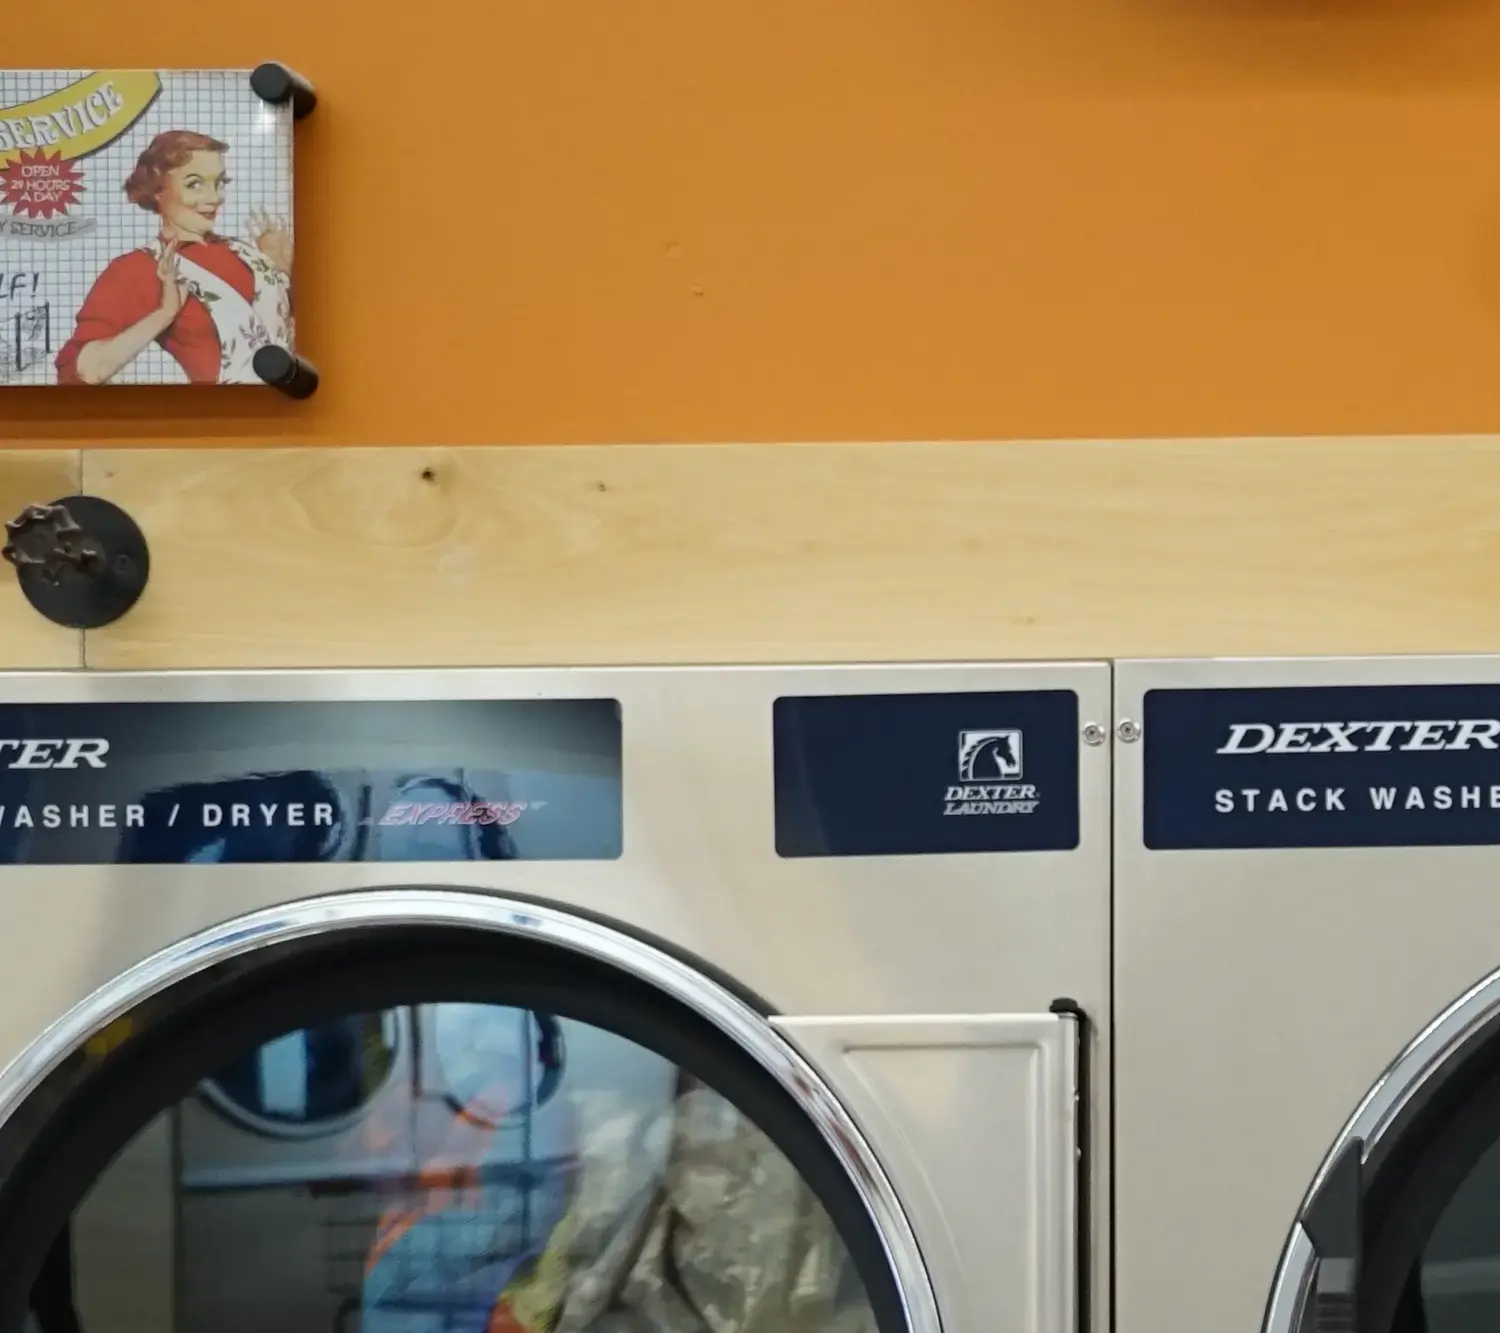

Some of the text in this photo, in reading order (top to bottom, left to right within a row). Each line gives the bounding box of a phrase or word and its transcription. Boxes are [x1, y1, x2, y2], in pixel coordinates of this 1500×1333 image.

[21, 165, 59, 177] OPEN
[27, 180, 71, 191] HOURS
[31, 191, 61, 202] DAY
[11, 221, 76, 236] SERVICE
[1217, 720, 1500, 753] DEXTER
[945, 785, 1039, 800] DEXTER
[1216, 788, 1344, 812] STACK
[0, 805, 144, 828] ASHER
[204, 804, 332, 826] DRYER
[376, 800, 527, 825] EXPRESS
[943, 801, 1038, 816] LAUNDRY
